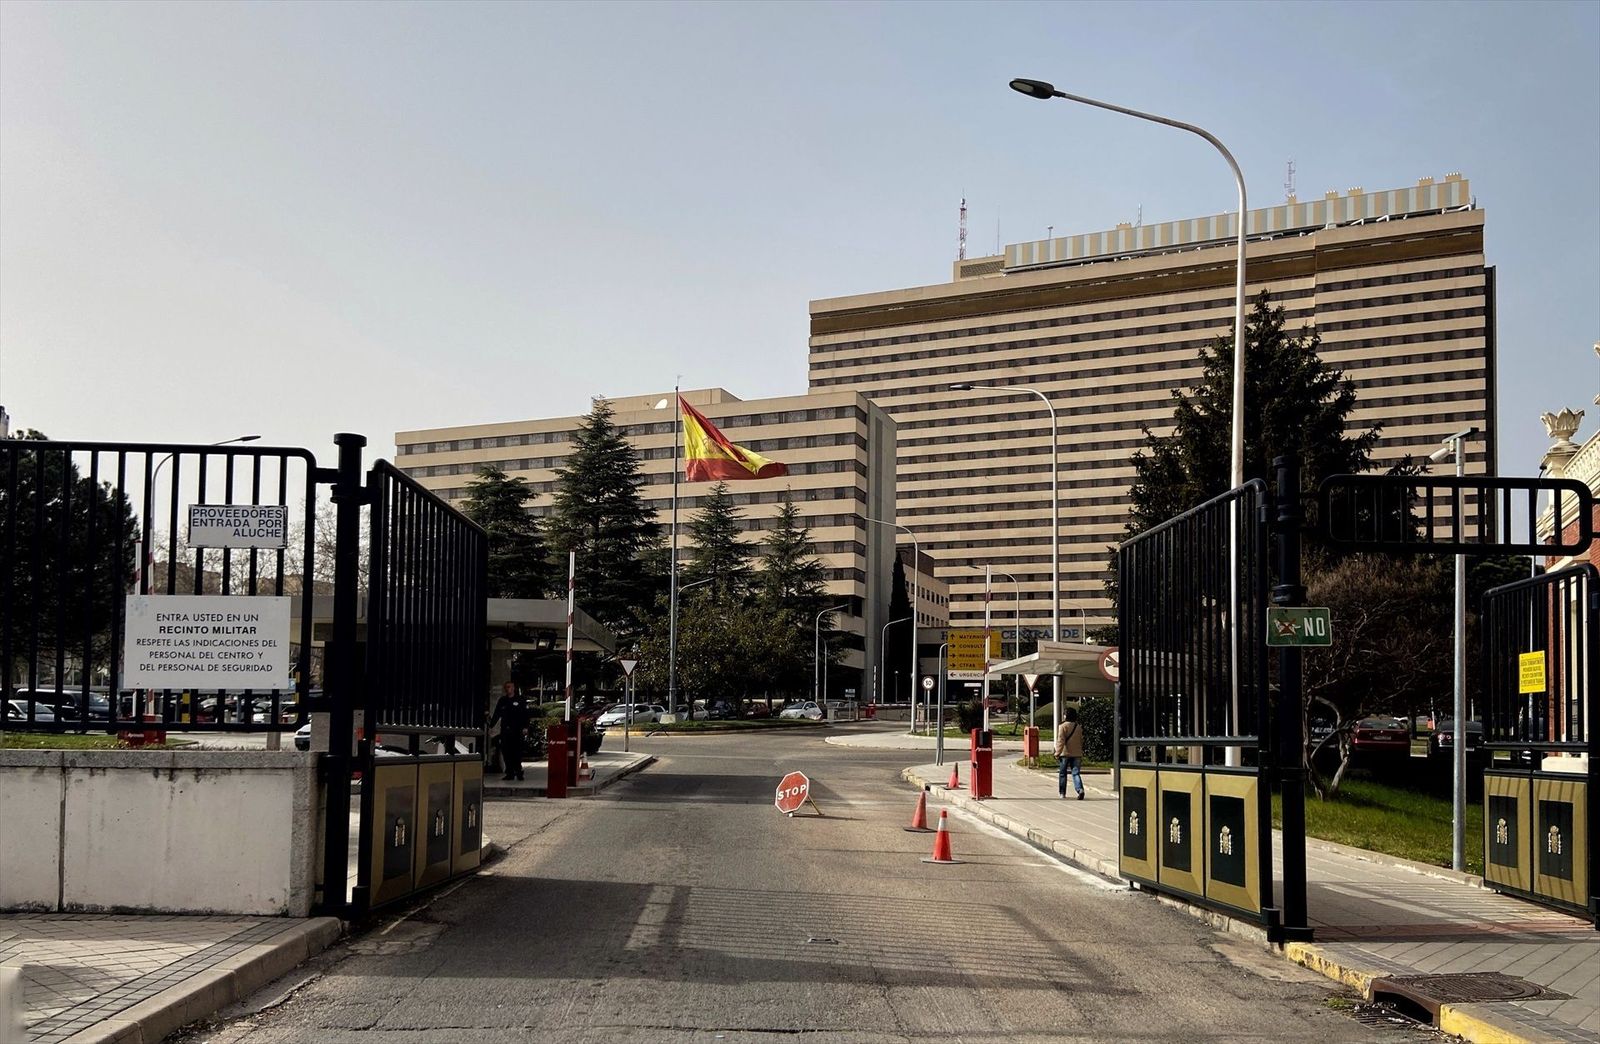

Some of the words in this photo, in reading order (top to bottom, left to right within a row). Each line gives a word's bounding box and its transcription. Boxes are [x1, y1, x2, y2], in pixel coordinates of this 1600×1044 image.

[192, 508, 283, 519] PROVEEDORES
[192, 518, 250, 528] ENTRADA
[258, 519, 282, 529] POR
[233, 528, 282, 538] ALUCHE
[156, 613, 190, 622] ENTRA
[193, 613, 223, 622] USTED
[227, 613, 241, 622] EN
[243, 613, 259, 622] UN
[159, 625, 209, 635] RECINTO
[212, 626, 257, 635] MILITAR
[1303, 617, 1325, 637] NO
[1062, 629, 1080, 639] DE
[136, 638, 171, 647] RESPETE
[174, 639, 190, 647] LAS
[193, 639, 260, 647] INDICACIONES
[262, 639, 278, 648] DEL
[149, 651, 196, 660] PERSONAL
[199, 651, 214, 660] DEL
[217, 651, 254, 660] CENTRO
[257, 651, 264, 660] Y
[139, 663, 155, 672] DEL
[157, 663, 205, 672] PERSONAL
[207, 663, 219, 672] DE
[222, 663, 273, 672] SEGURIDAD
[777, 784, 807, 801] STOP
